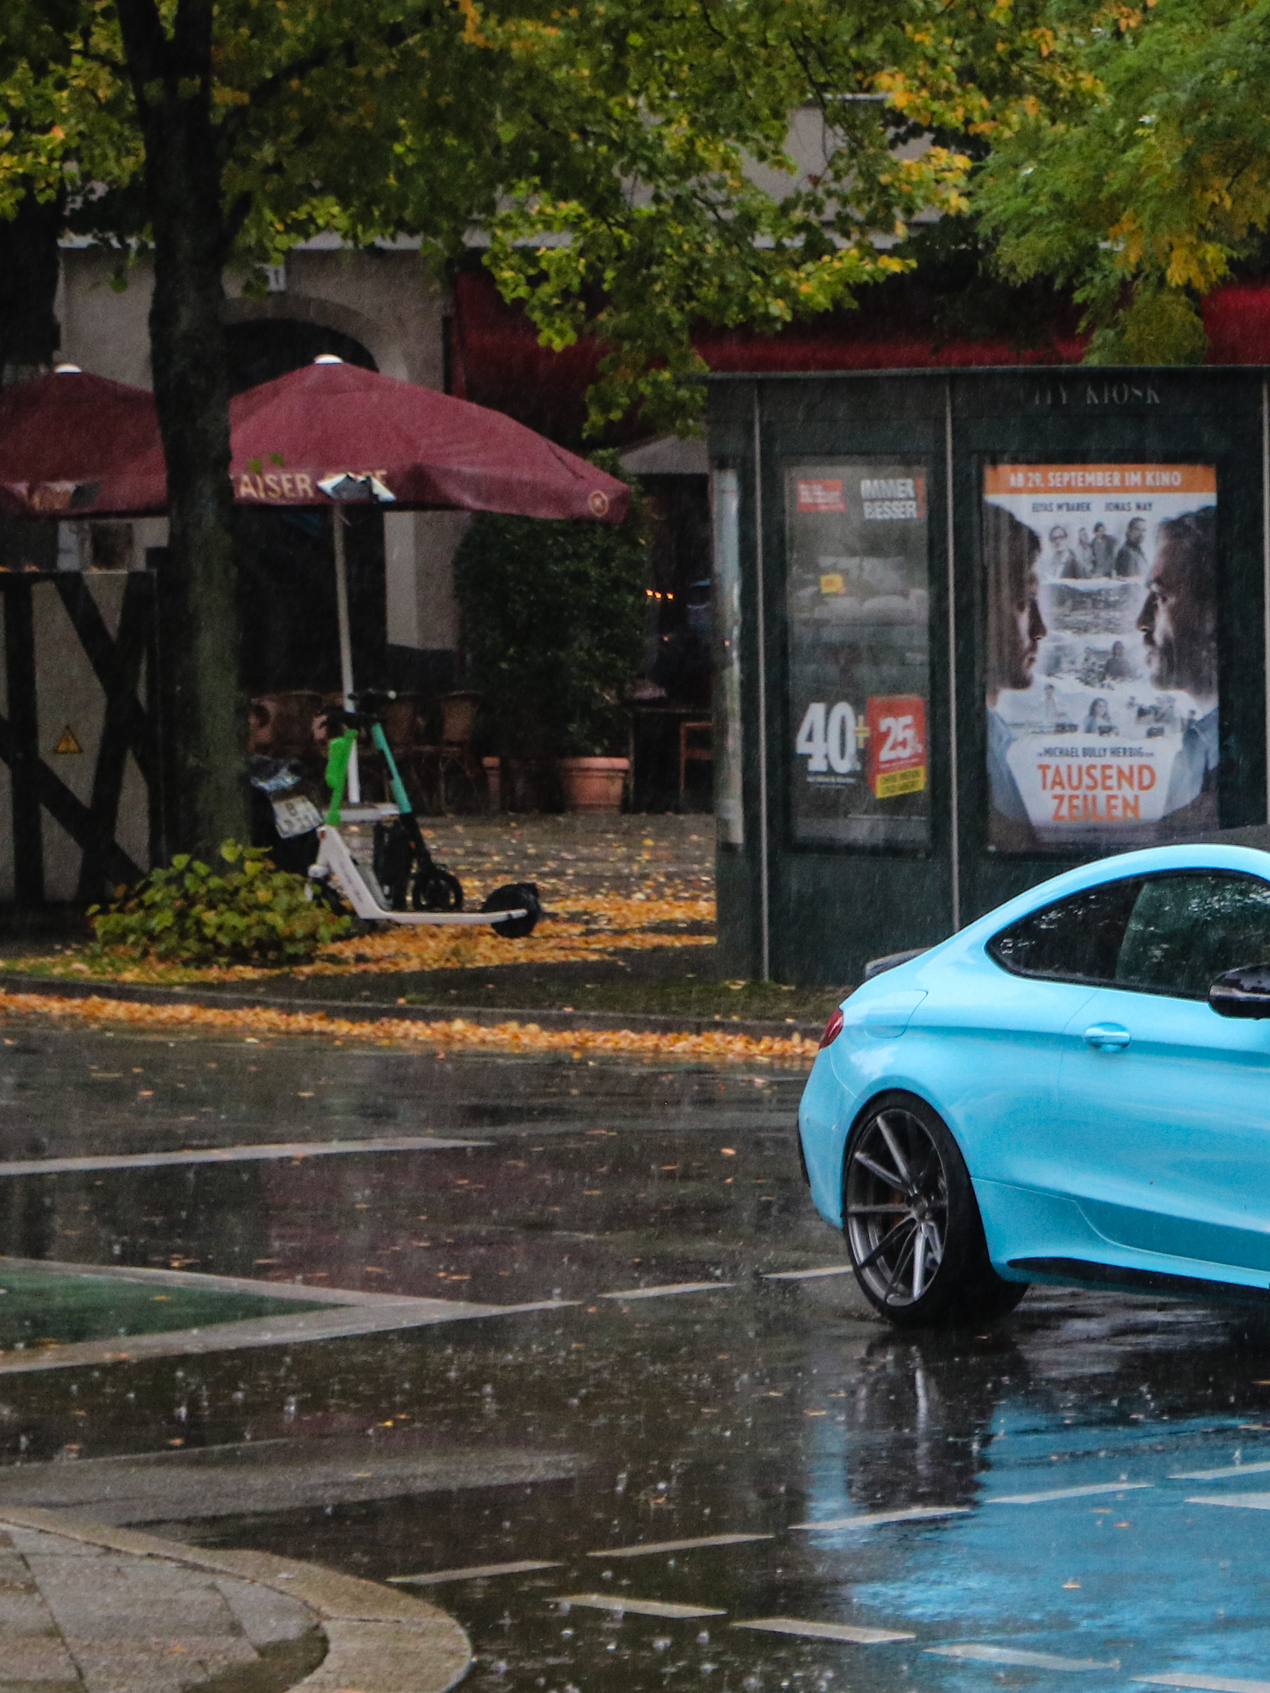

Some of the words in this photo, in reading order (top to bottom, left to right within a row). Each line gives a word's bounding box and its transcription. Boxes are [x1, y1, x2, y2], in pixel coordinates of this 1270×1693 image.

[230, 472, 314, 498] AISER
[1009, 473, 1026, 487] AB
[1047, 472, 1121, 487] SEPTEMBER
[1124, 472, 1142, 486] IM
[1145, 471, 1182, 486] KINO
[1043, 747, 1080, 758] MICHAEL
[1037, 764, 1157, 791] TAUSEND
[1052, 794, 1141, 821] ZEILEN
